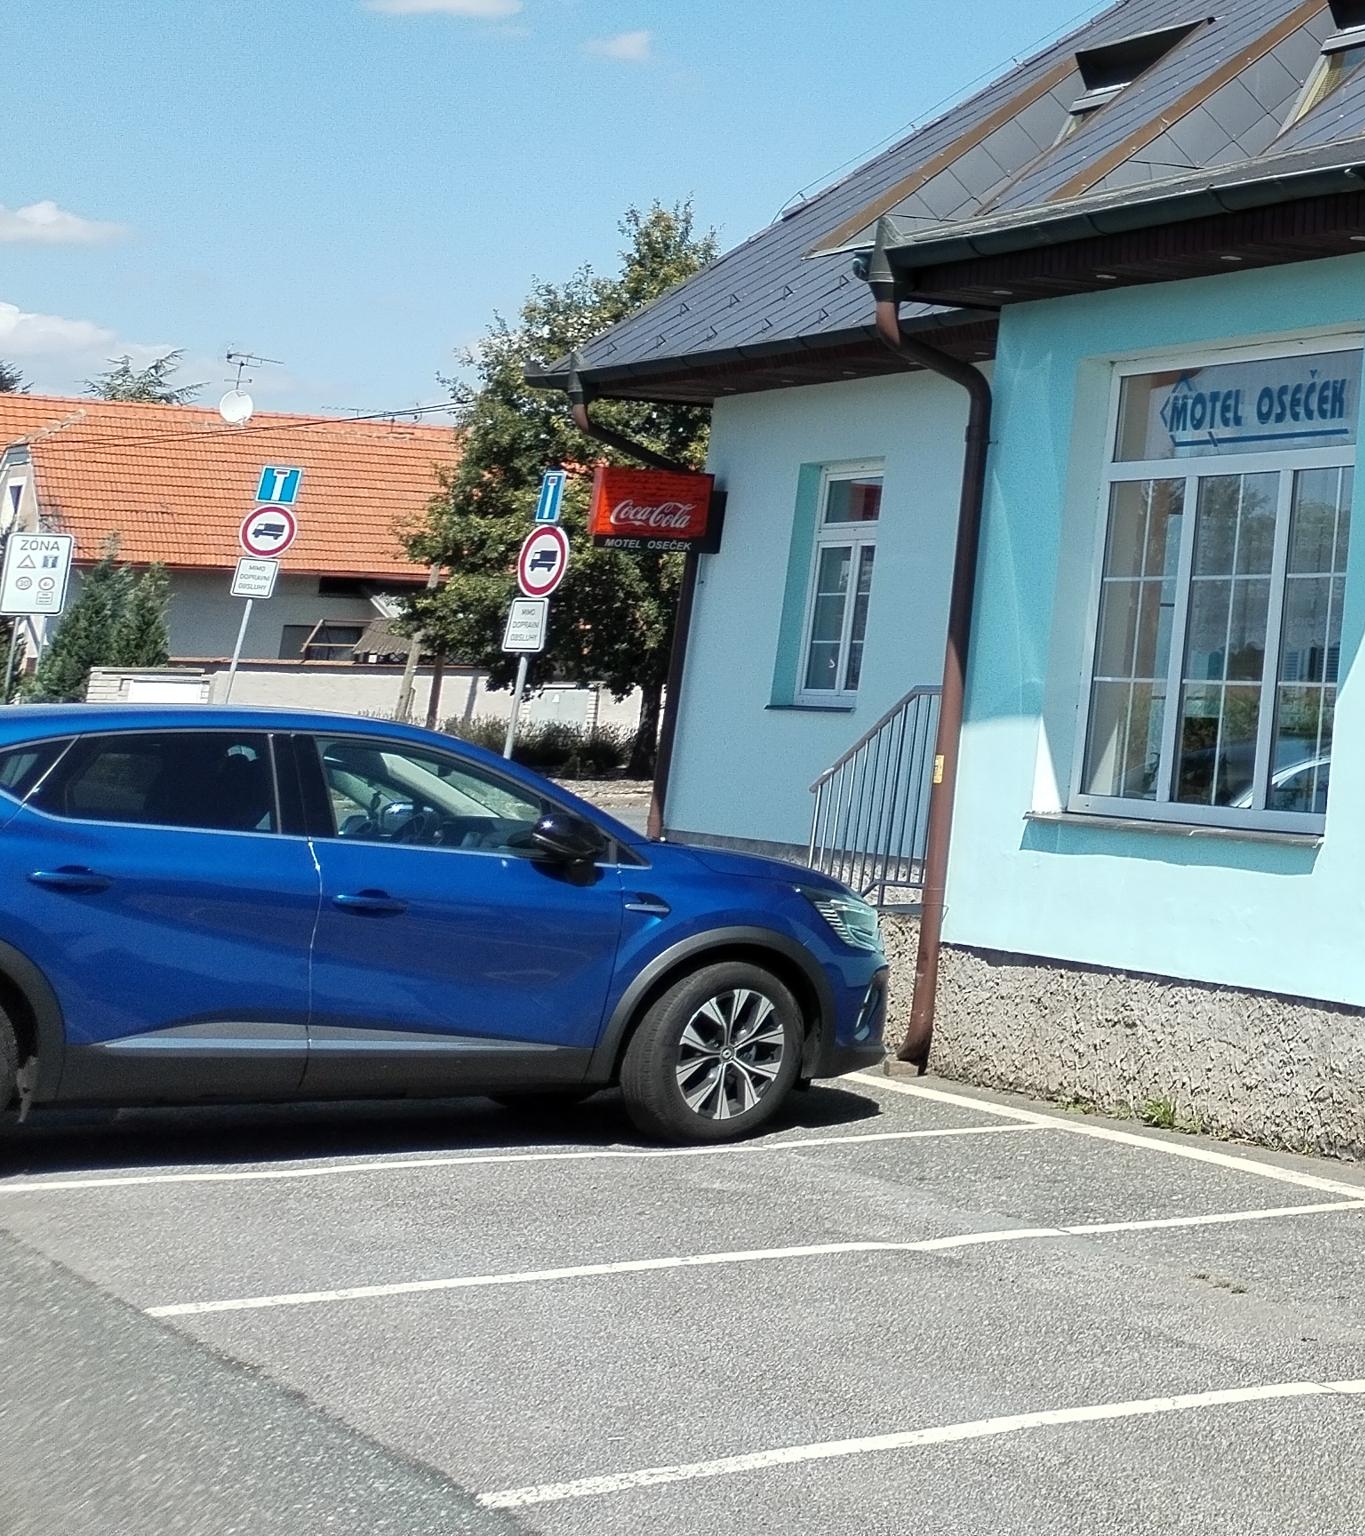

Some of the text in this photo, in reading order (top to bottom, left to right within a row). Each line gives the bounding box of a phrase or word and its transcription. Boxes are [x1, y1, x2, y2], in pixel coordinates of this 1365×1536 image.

[1168, 368, 1348, 433] MOTEL OSEČEK
[20, 537, 60, 551] ZÓNA
[604, 538, 693, 551] MOTEL OSEČEK
